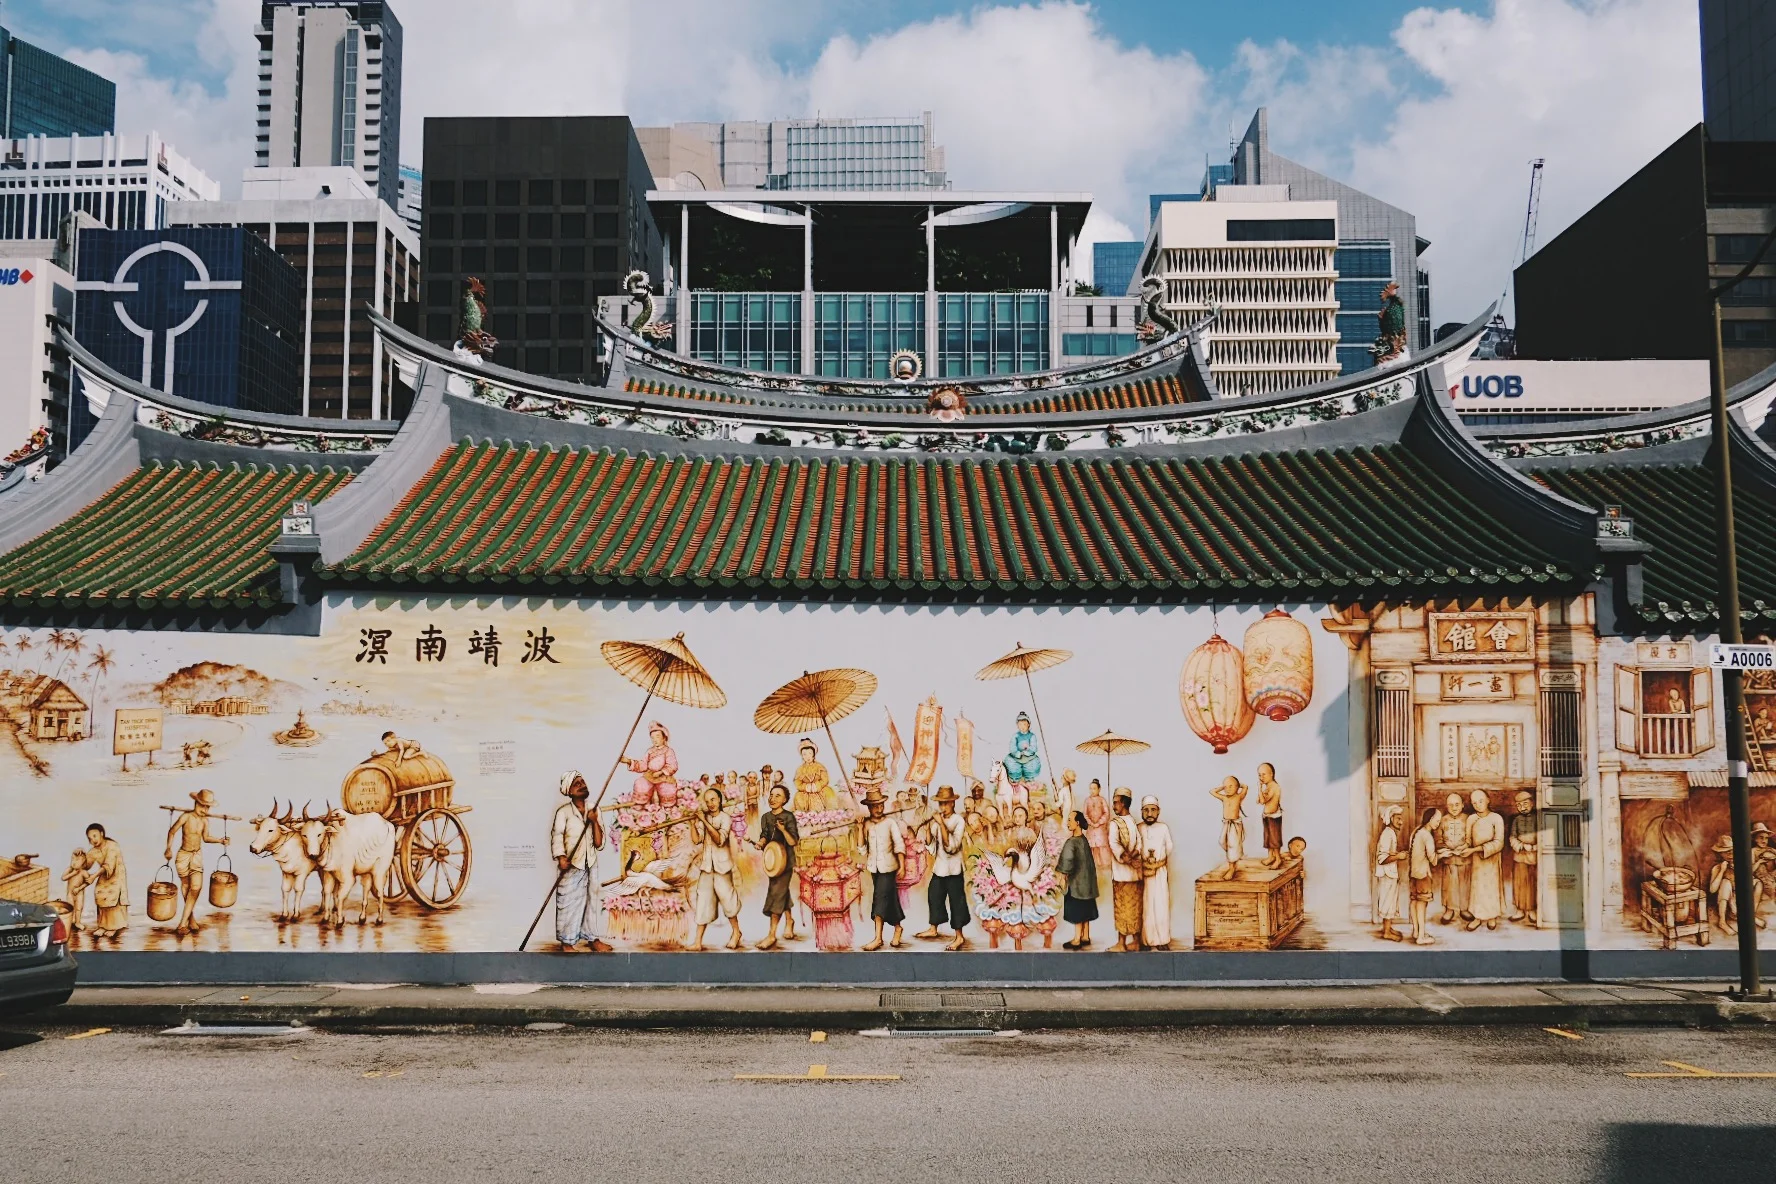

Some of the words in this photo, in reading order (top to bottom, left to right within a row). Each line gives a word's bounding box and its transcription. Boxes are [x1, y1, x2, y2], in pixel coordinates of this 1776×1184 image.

[1463, 375, 1524, 398] UOB
[1731, 652, 1773, 667] A0006
[0, 934, 36, 948] L9398A
